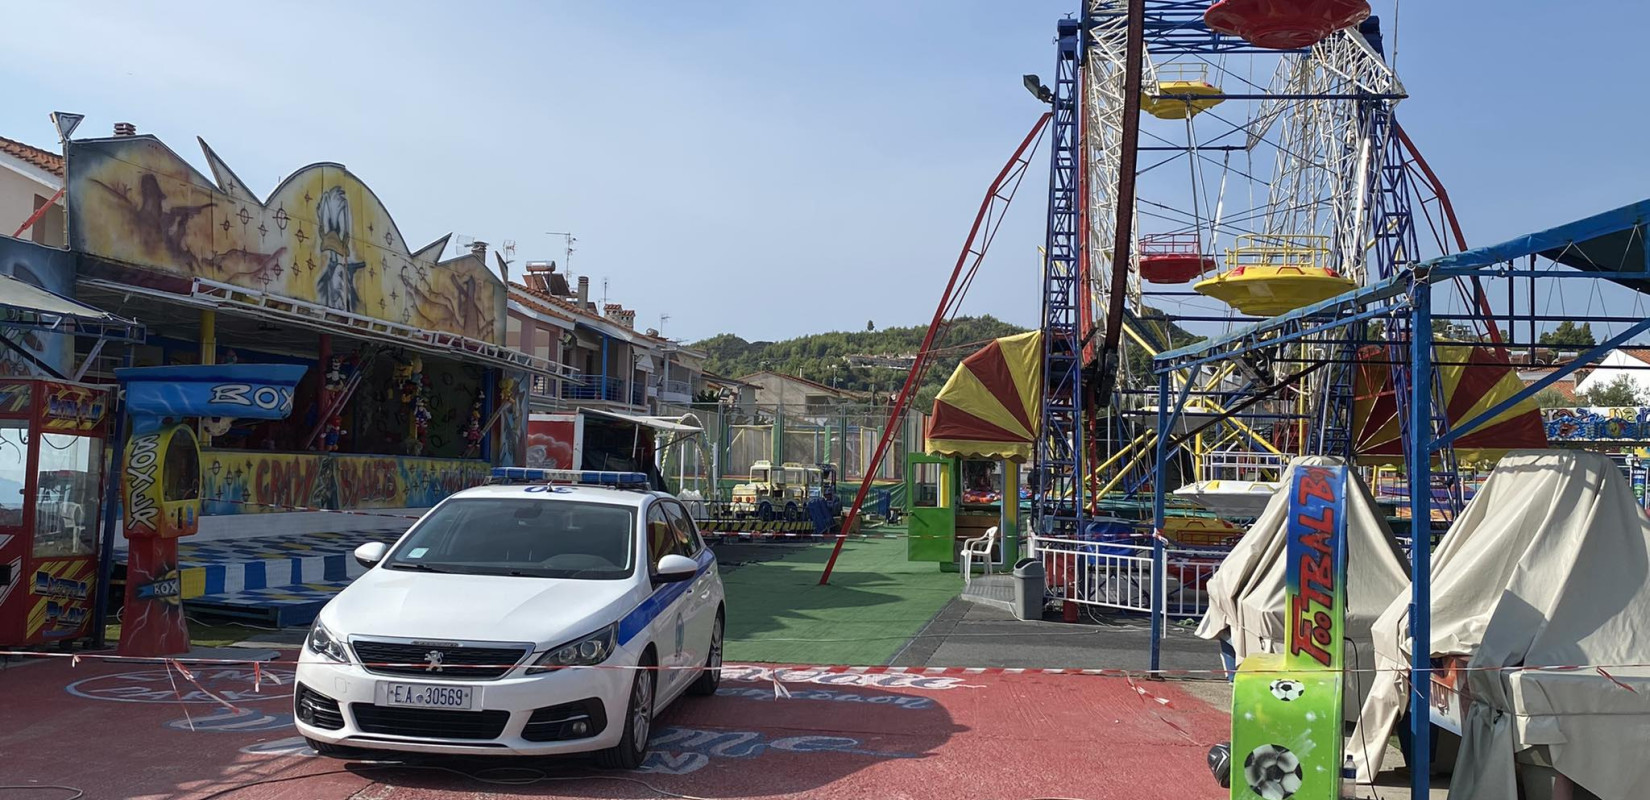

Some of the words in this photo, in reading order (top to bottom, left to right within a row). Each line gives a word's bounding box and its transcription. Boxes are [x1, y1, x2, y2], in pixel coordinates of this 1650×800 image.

[208, 384, 294, 412] BOX
[127, 434, 160, 530] BOXER
[154, 579, 178, 596] BOX
[425, 687, 463, 706] 30569
